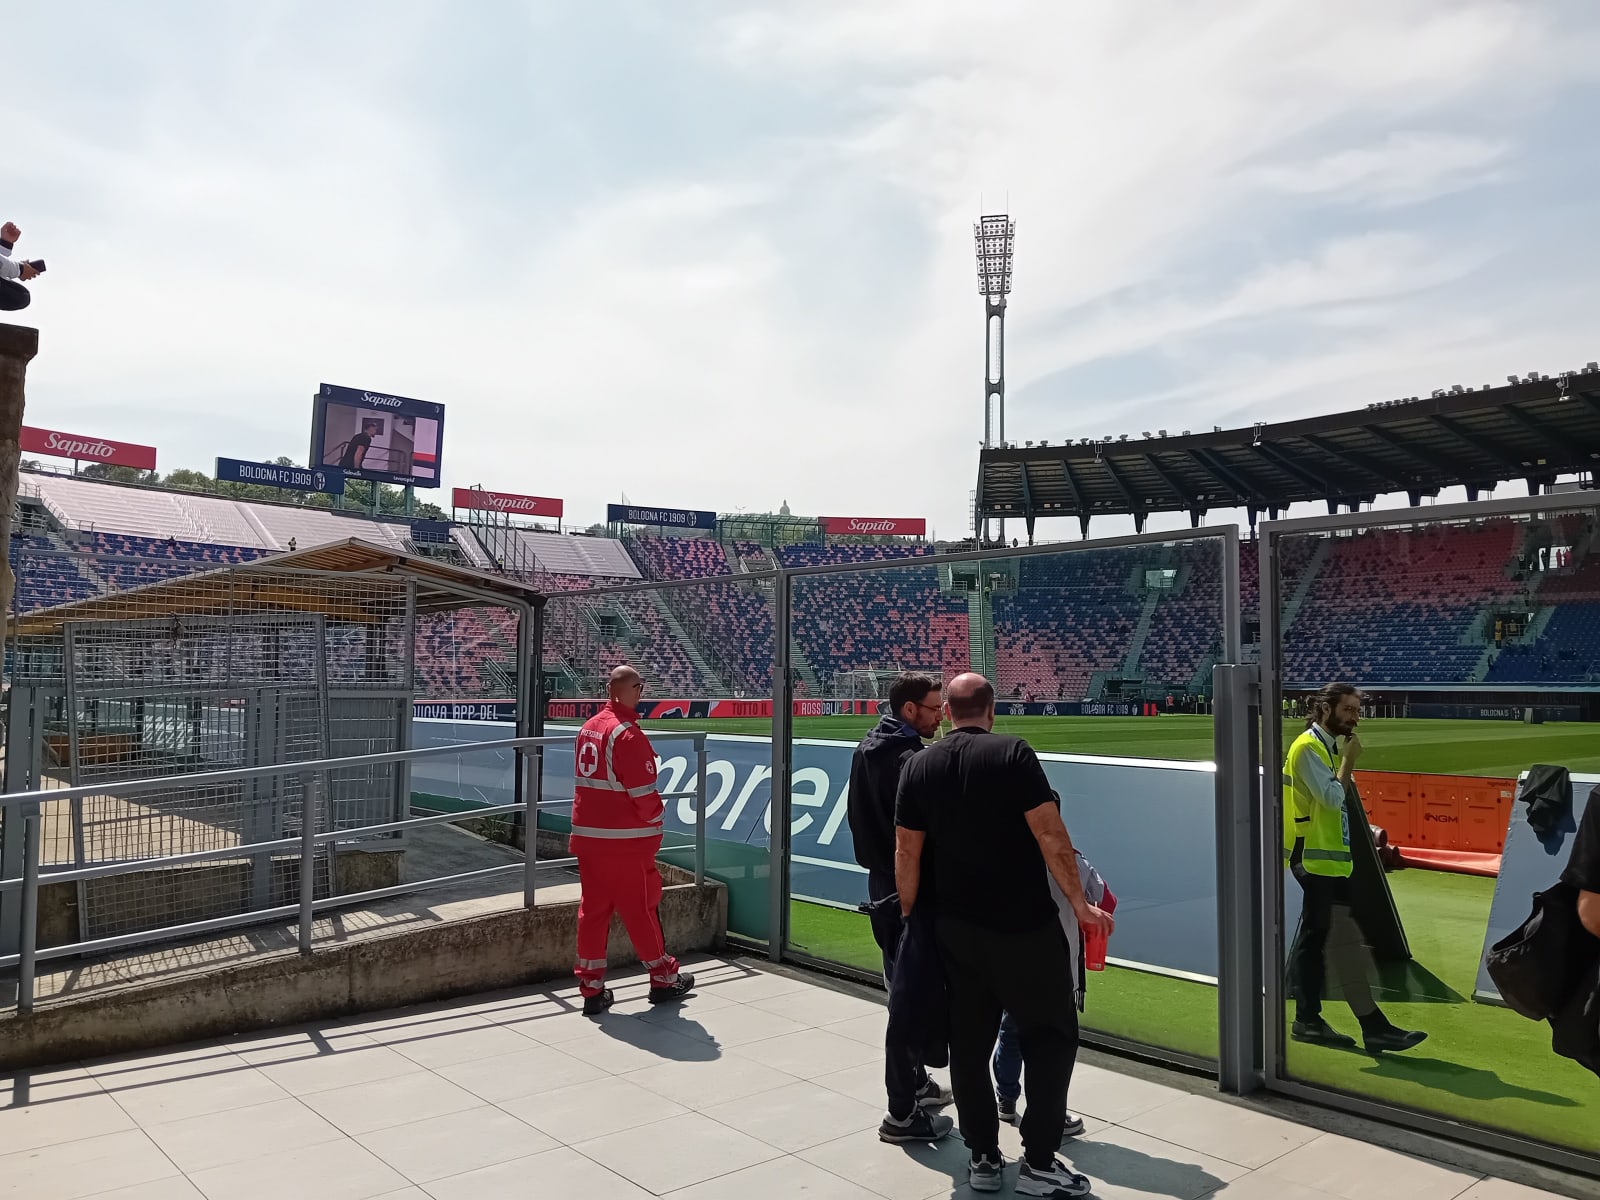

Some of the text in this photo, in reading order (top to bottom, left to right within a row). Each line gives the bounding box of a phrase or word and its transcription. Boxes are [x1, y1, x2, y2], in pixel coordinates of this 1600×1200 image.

[361, 392, 403, 408] Saputo
[44, 432, 116, 458] Saputo
[239, 464, 312, 486] BOLOGNA FC 1909
[483, 493, 536, 511] Saputo
[628, 509, 686, 524] BOLOGNA FC 1909
[847, 518, 897, 534] Saputo
[452, 704, 475, 719] APP
[480, 704, 498, 720] DEL
[732, 702, 758, 715] TUTTO
